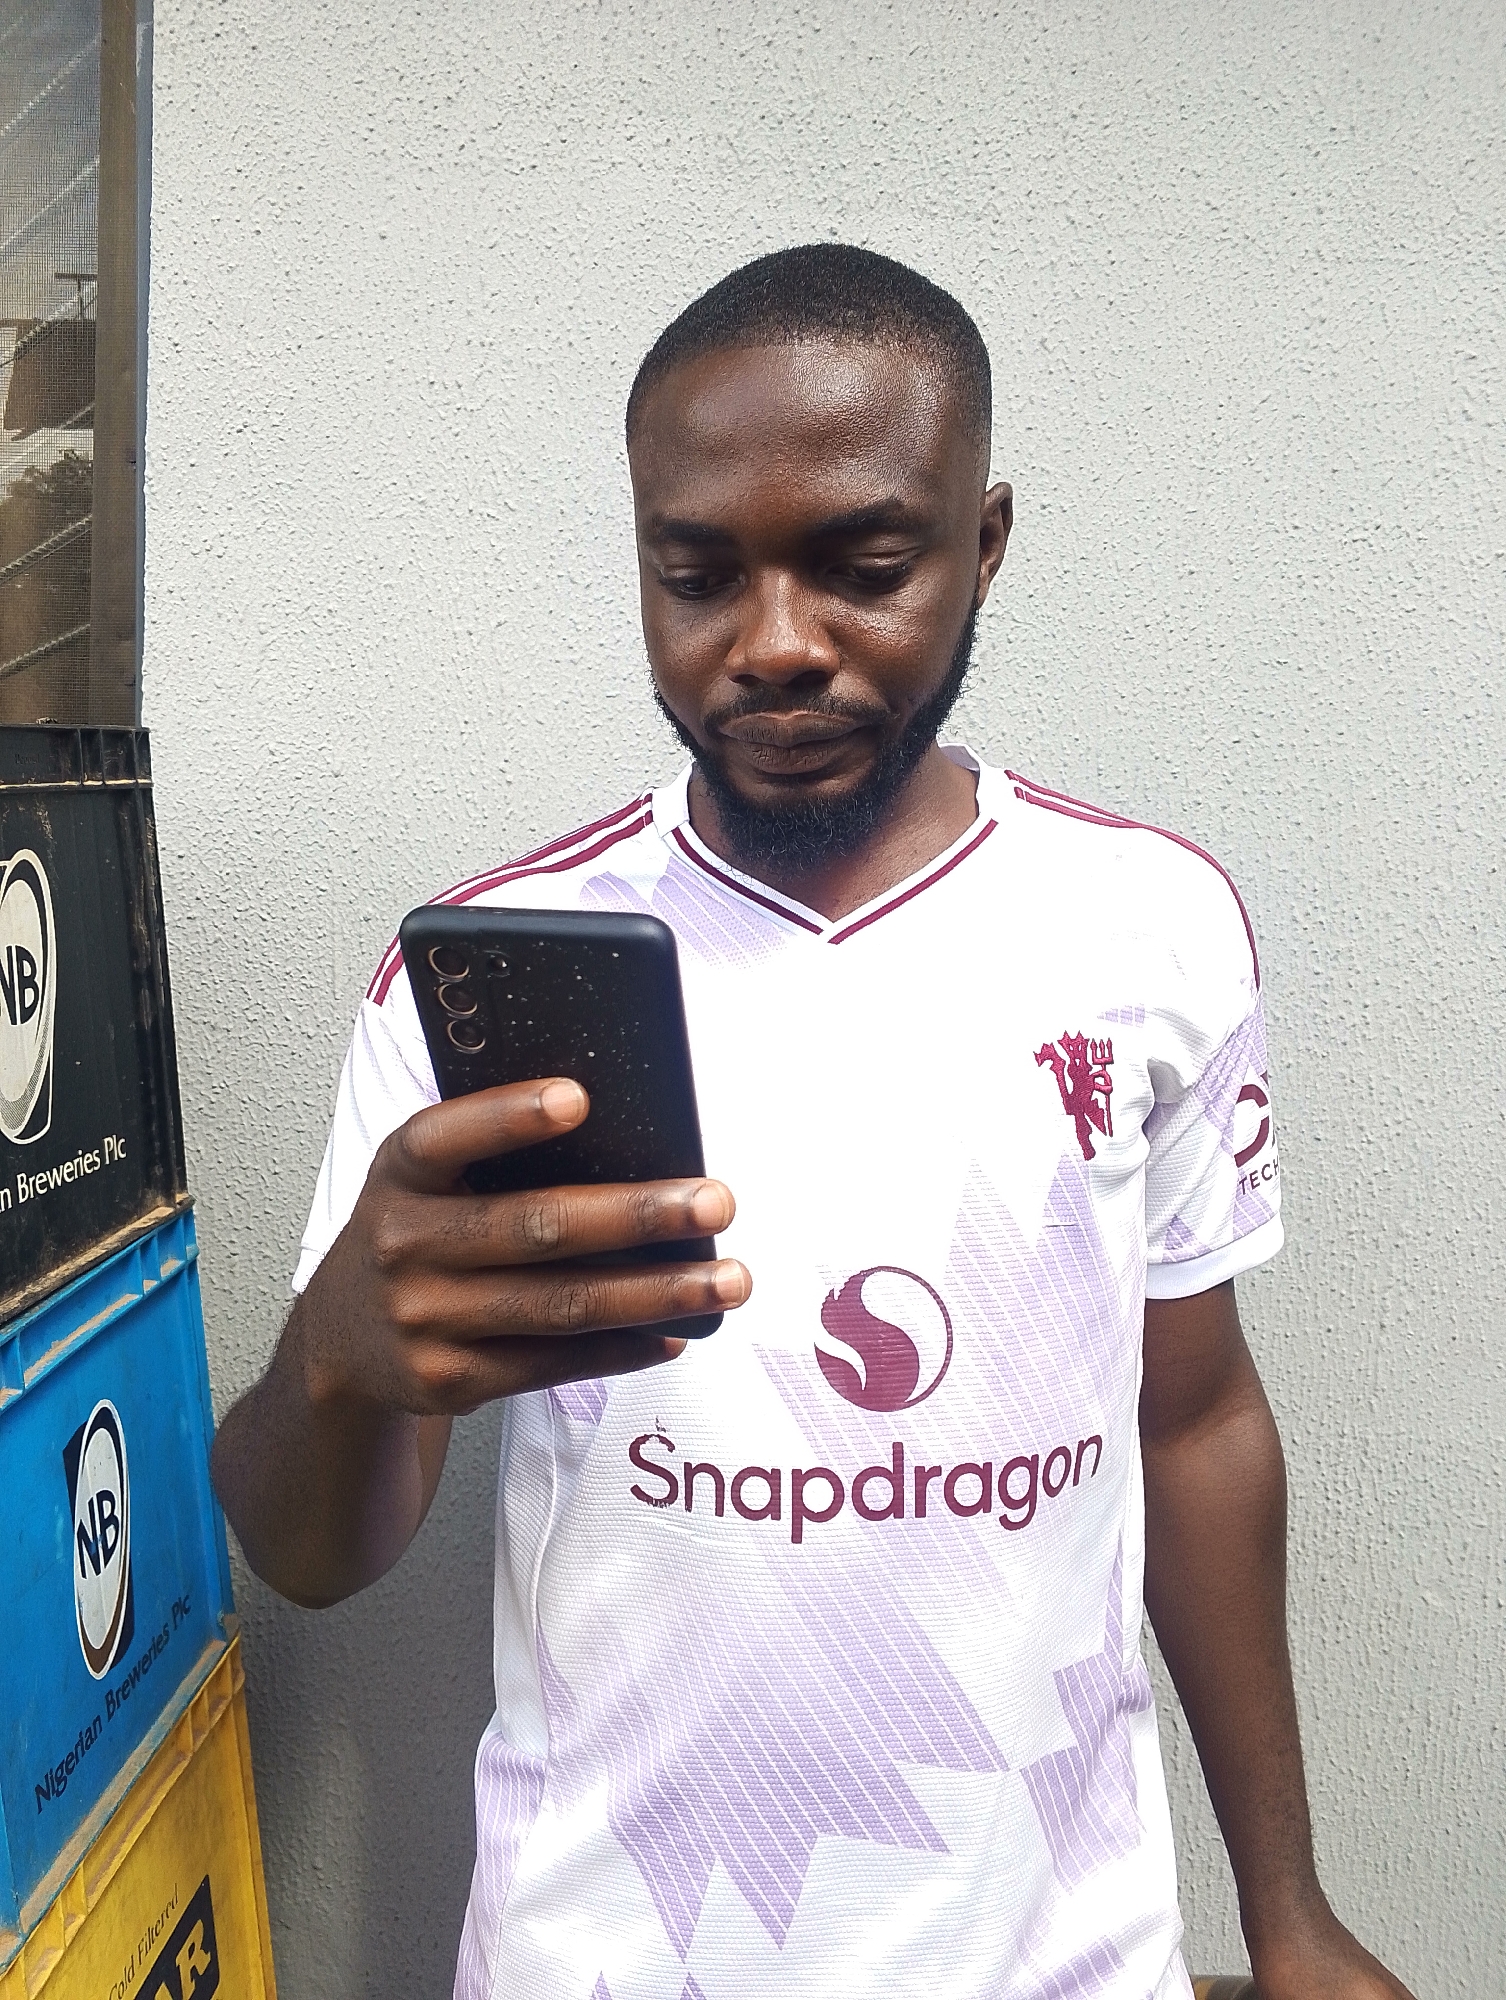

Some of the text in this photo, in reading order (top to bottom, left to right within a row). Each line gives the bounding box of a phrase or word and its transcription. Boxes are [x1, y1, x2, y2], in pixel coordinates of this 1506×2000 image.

[17, 1149, 101, 1204] Breweries
[103, 1134, 127, 1165] Plc
[77, 1489, 119, 1580] NB
[629, 1433, 1103, 1544] Snapdragon
[35, 1595, 191, 1814] Nigerian Breweries Plc
[109, 1882, 178, 2000] Cold Filtered
